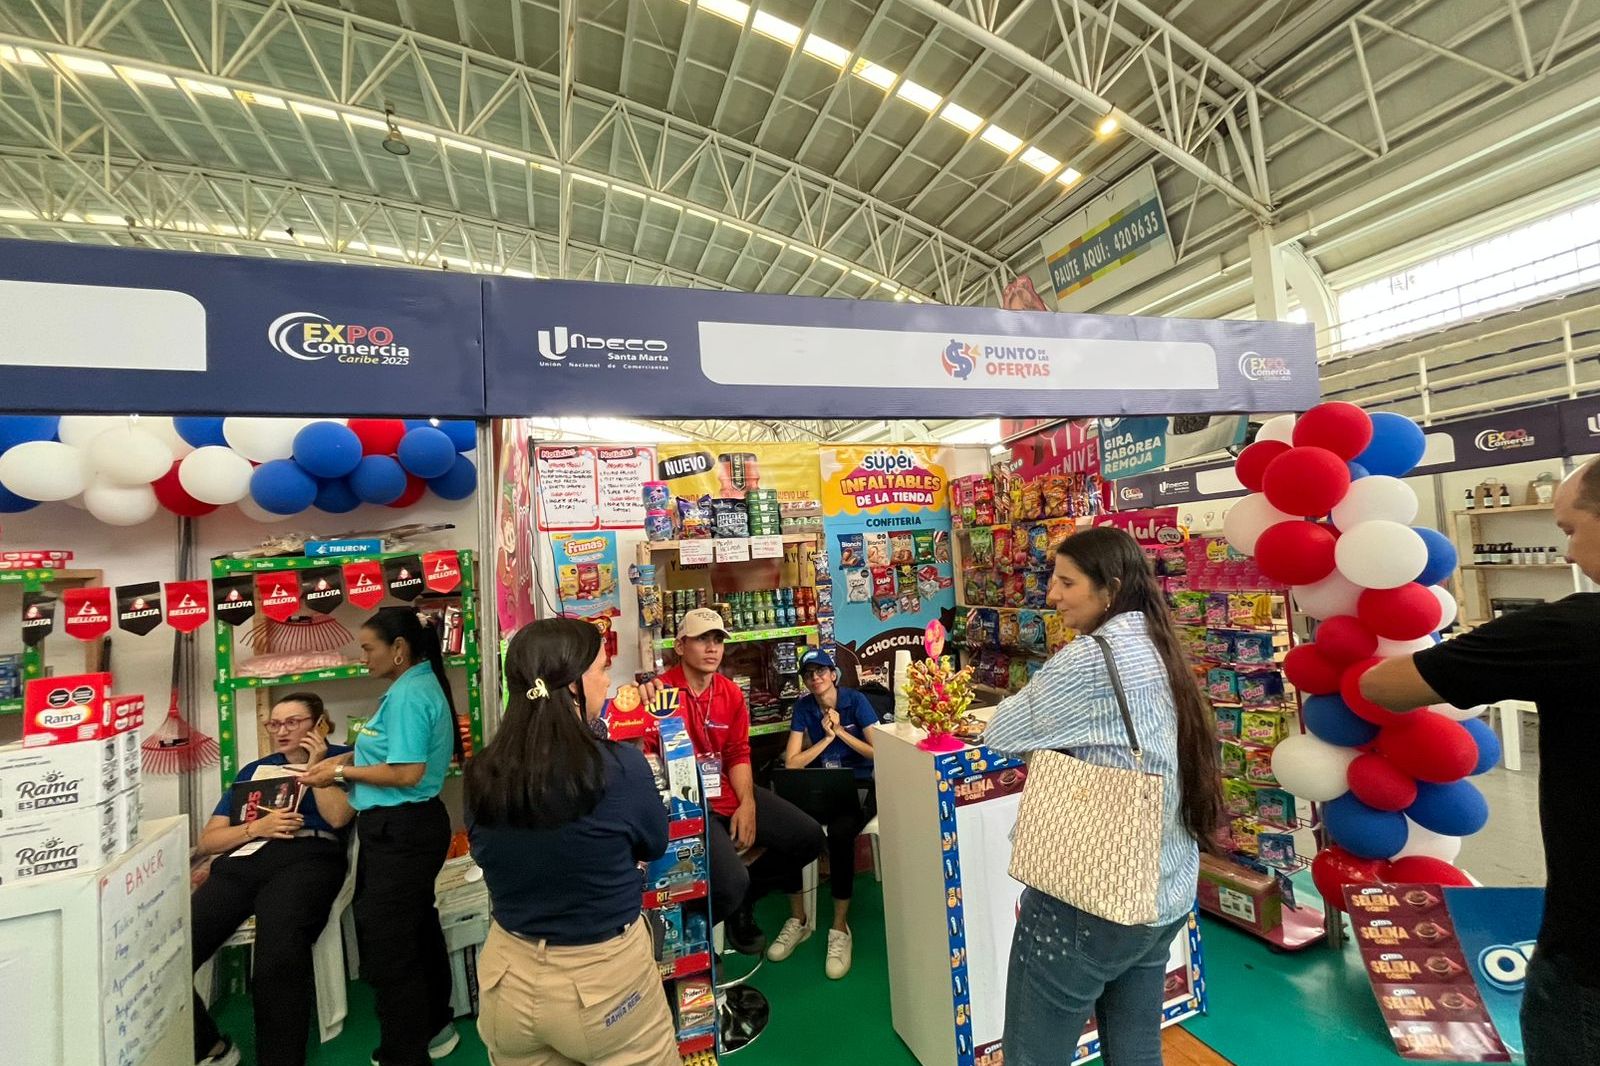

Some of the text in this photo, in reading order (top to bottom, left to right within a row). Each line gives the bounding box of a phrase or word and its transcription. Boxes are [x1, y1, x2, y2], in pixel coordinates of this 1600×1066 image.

[1054, 258, 1081, 287] PAUTE
[303, 322, 394, 346] EXPO
[302, 339, 410, 357] Comercia
[984, 346, 1037, 360] PUNTO
[338, 354, 409, 366] Caribe 2025
[607, 352, 669, 362] Santa Marta
[985, 362, 1051, 379] OFERTAS
[1250, 367, 1291, 377] Comercia
[1104, 432, 1134, 450] GIRA
[1487, 428, 1527, 444] EXPO
[1487, 436, 1535, 448] Comercia
[541, 449, 577, 459] Noticias
[600, 449, 634, 459] Noticias
[1104, 435, 1162, 463] SABOREA
[664, 455, 707, 476] NUEVO
[1104, 452, 1153, 475] REMOJA
[840, 474, 941, 495] INFALTABLES
[855, 490, 934, 507] DE LA TIENDA
[566, 540, 603, 554] Frunas
[427, 568, 459, 581] BELLOTA
[349, 584, 382, 595] BELLOTA
[390, 577, 422, 589] BELLOTA
[263, 595, 297, 607] BELLOTA
[307, 588, 341, 600] BELLOTA
[169, 607, 207, 617] BELLOTA
[217, 599, 253, 611] BELLOTA
[67, 615, 108, 624] BELLOTA
[121, 608, 160, 620] BELLOTA
[23, 618, 51, 628] LLOTA
[44, 711, 81, 725] Rama
[1248, 729, 1273, 737] Trolli
[16, 779, 83, 799] Rama
[955, 778, 995, 797] SELENA
[18, 794, 78, 811] ES RAMA
[16, 844, 83, 866] Rama
[18, 859, 77, 878] ES RAMA
[125, 849, 165, 896] BAYER
[656, 890, 671, 903] RITZ
[1351, 894, 1400, 907] SELENA
[1360, 926, 1411, 939] SELENA
[1370, 960, 1422, 974] SELENA
[683, 987, 709, 999] Trident
[1382, 996, 1436, 1010] SELENA
